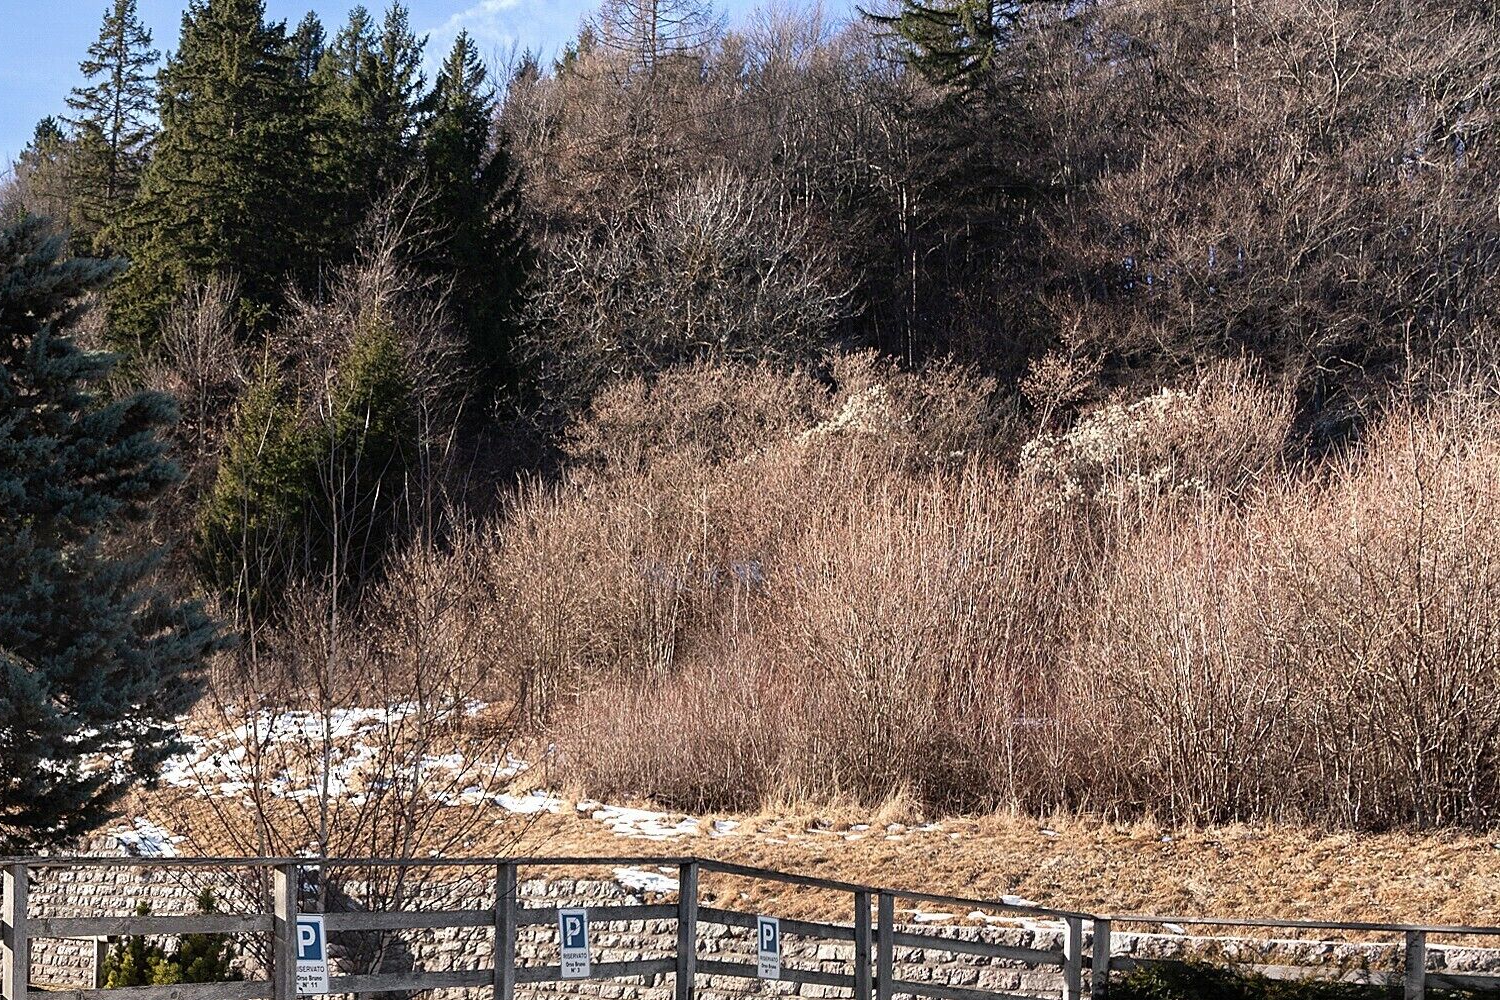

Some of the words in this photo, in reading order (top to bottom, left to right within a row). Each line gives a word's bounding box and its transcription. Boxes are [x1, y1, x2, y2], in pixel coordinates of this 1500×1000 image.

[297, 925, 316, 956] P
[566, 917, 580, 946] P
[763, 924, 774, 950] P
